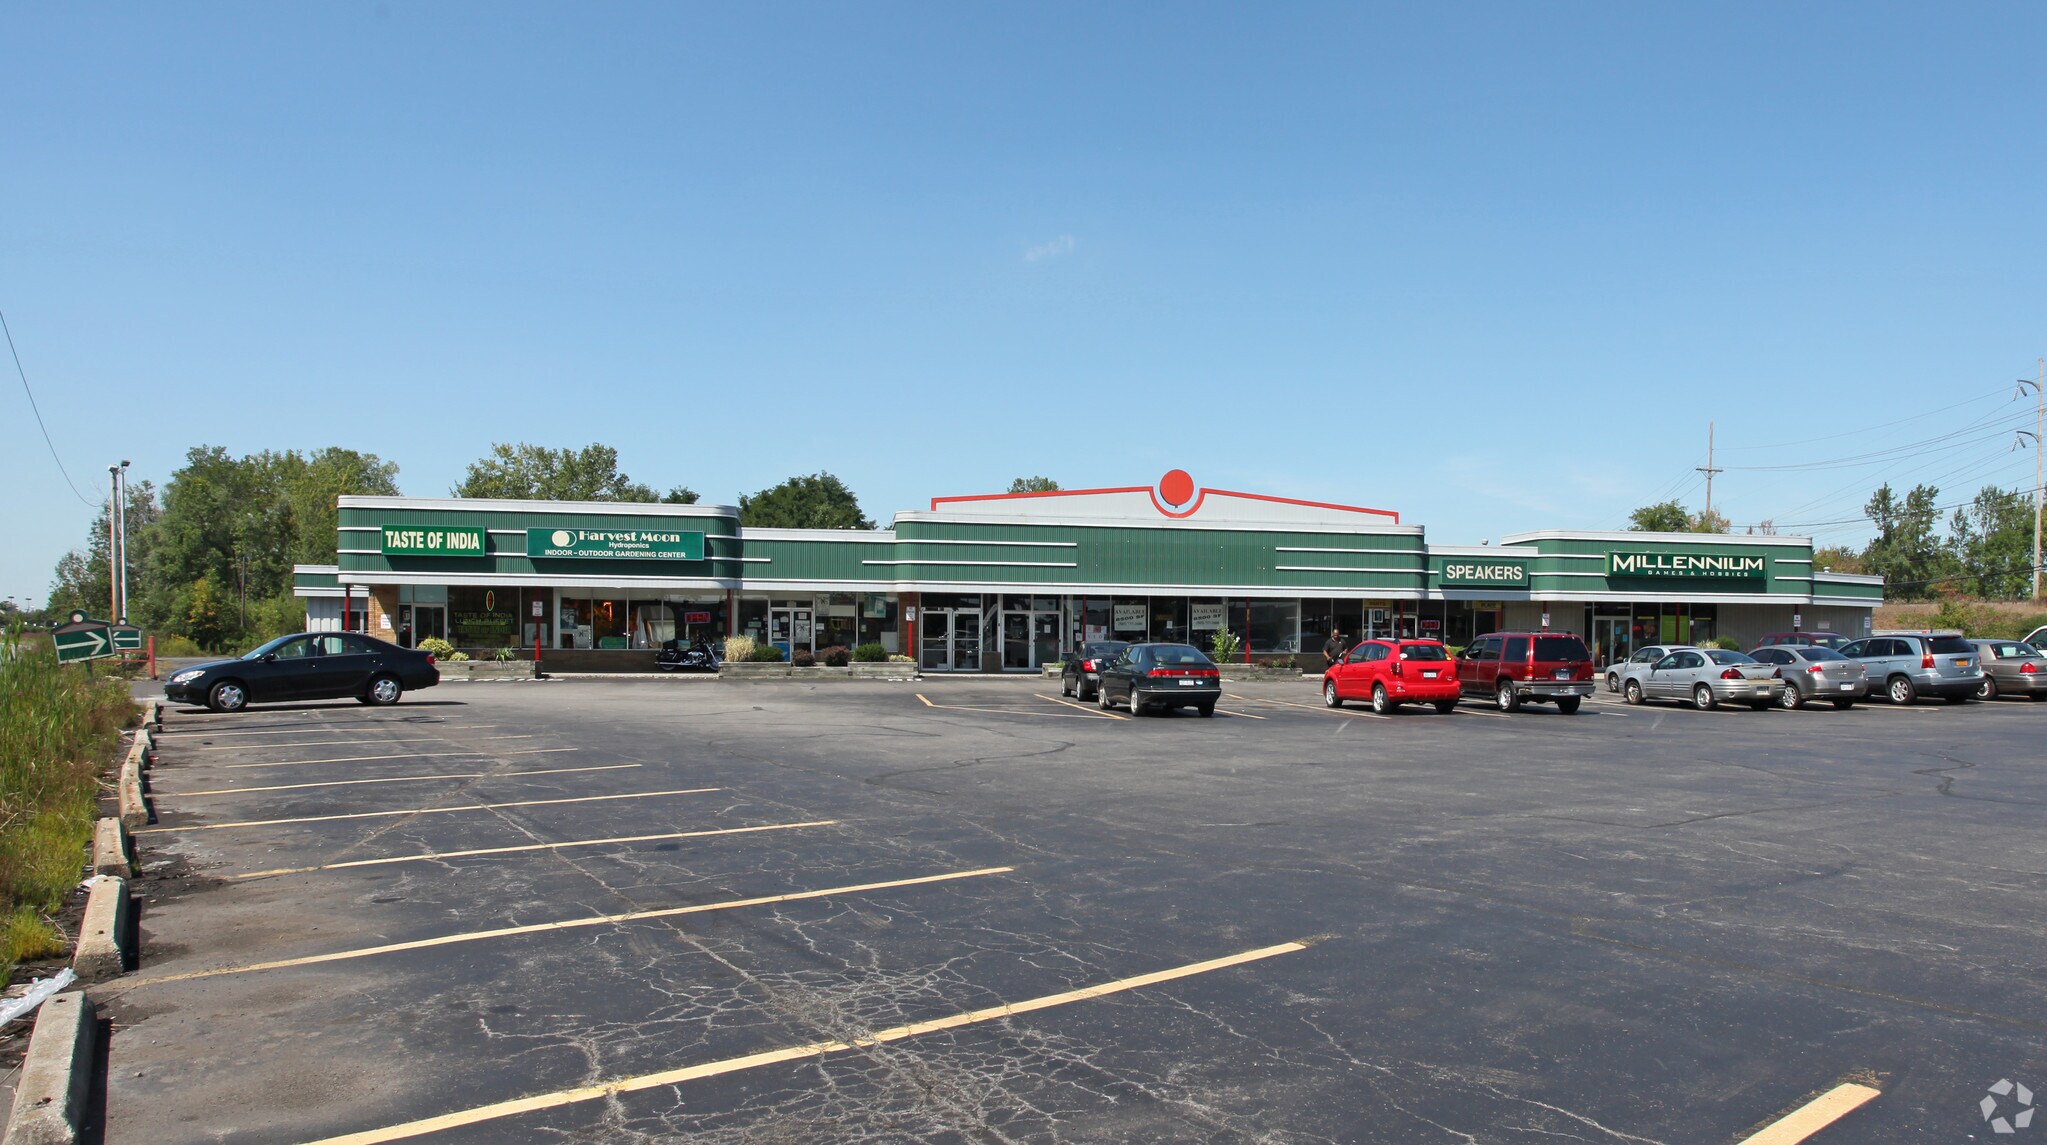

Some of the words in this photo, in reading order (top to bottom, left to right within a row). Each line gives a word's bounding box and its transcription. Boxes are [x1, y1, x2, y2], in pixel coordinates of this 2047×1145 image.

[385, 531, 424, 548] TASTE
[427, 531, 443, 549] OF
[446, 532, 480, 549] INDIA
[579, 530, 637, 542] Harvest
[640, 532, 681, 542] Moon
[1613, 554, 1763, 572] MILLENNIUM
[1446, 565, 1523, 580] SPEAKERS
